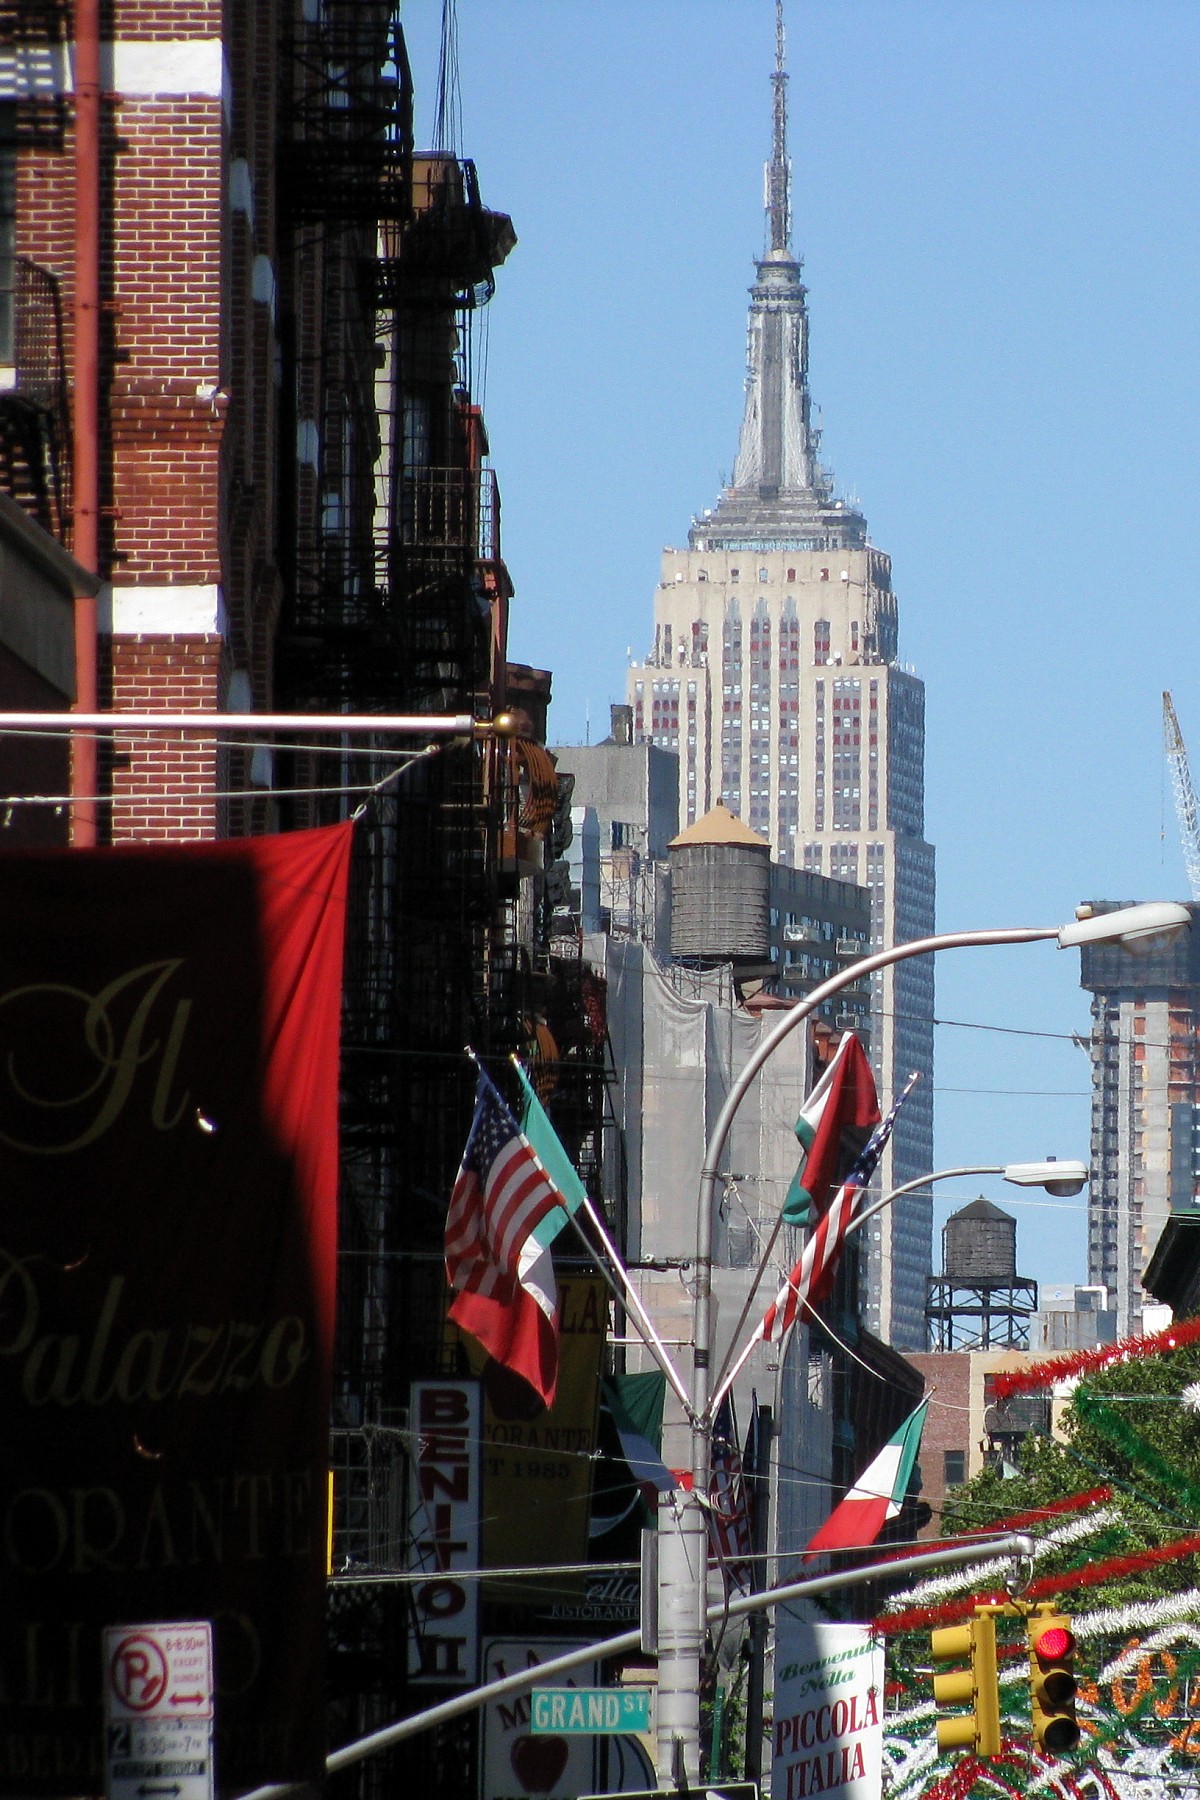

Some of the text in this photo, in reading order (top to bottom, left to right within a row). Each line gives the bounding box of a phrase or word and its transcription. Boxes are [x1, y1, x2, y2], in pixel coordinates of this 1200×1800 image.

[419, 1389, 469, 1617] BENITO
[535, 1694, 620, 1728] GRAND
[624, 1694, 646, 1713] ST
[775, 1688, 879, 1758] PICCOLA
[785, 1742, 866, 1800] ITALIA
